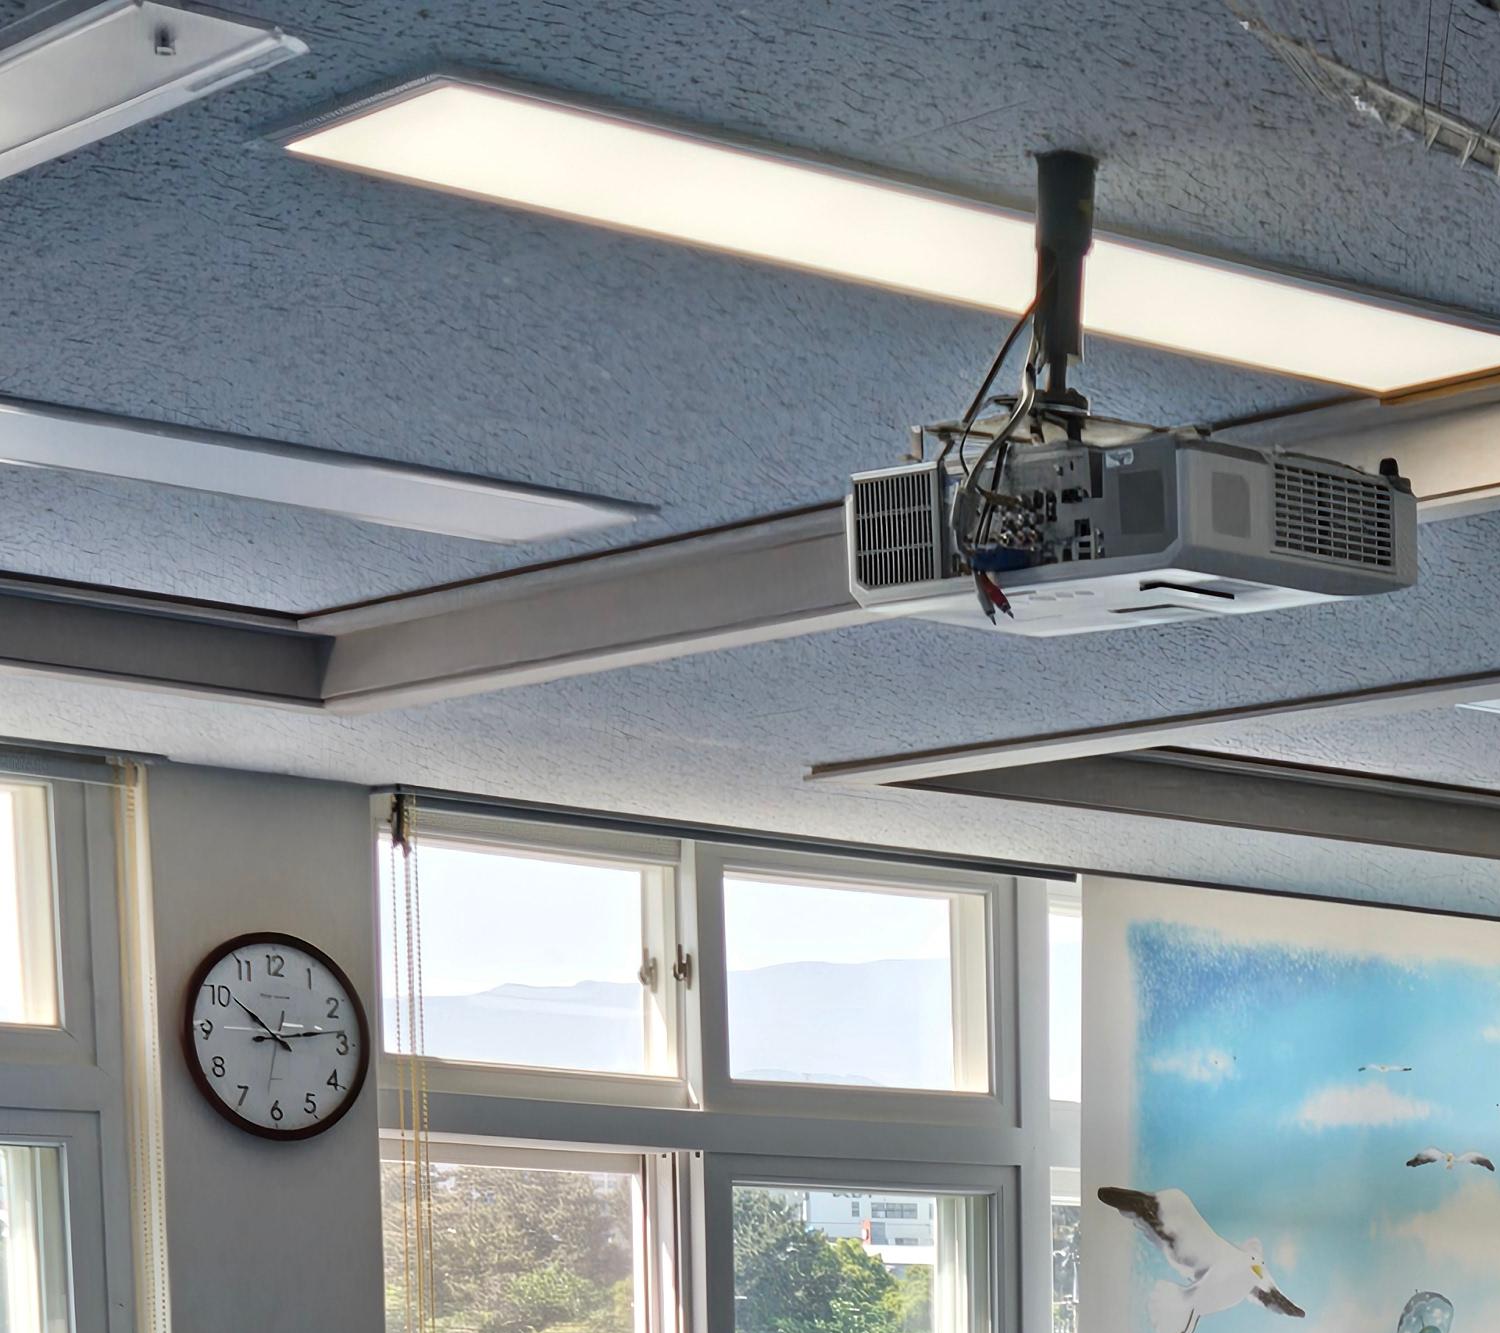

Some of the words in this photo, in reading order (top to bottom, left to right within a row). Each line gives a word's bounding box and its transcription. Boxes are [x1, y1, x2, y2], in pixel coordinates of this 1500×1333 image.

[234, 953, 252, 982] 11
[265, 954, 285, 978] 12
[306, 967, 312, 991] 1
[204, 984, 231, 1008] 10
[326, 997, 339, 1020] 2
[200, 1018, 213, 1041] 9
[335, 1033, 349, 1056] 3
[211, 1055, 226, 1078] 8
[326, 1068, 339, 1091] 4
[236, 1085, 249, 1107] 7
[303, 1093, 317, 1115] 5
[270, 1099, 284, 1121] 6
